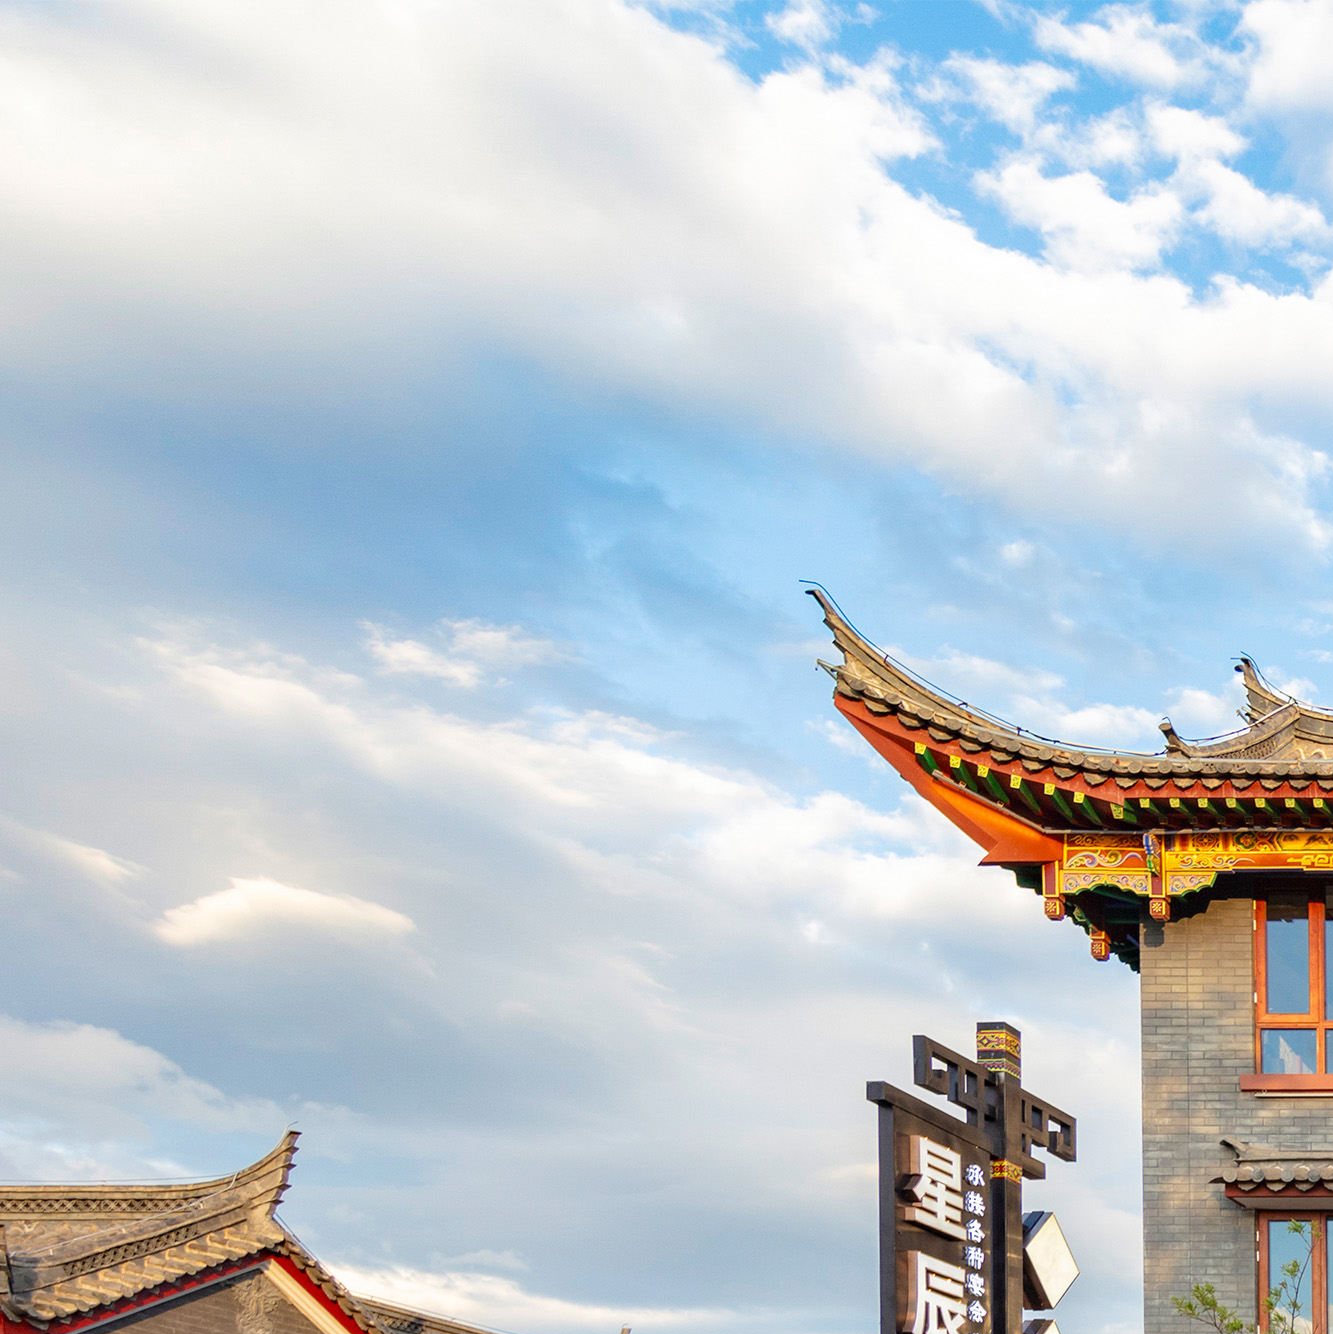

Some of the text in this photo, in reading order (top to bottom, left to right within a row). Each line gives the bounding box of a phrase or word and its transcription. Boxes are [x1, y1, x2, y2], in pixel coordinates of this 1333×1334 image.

[965, 1164, 988, 1324] 承接各种宴会
